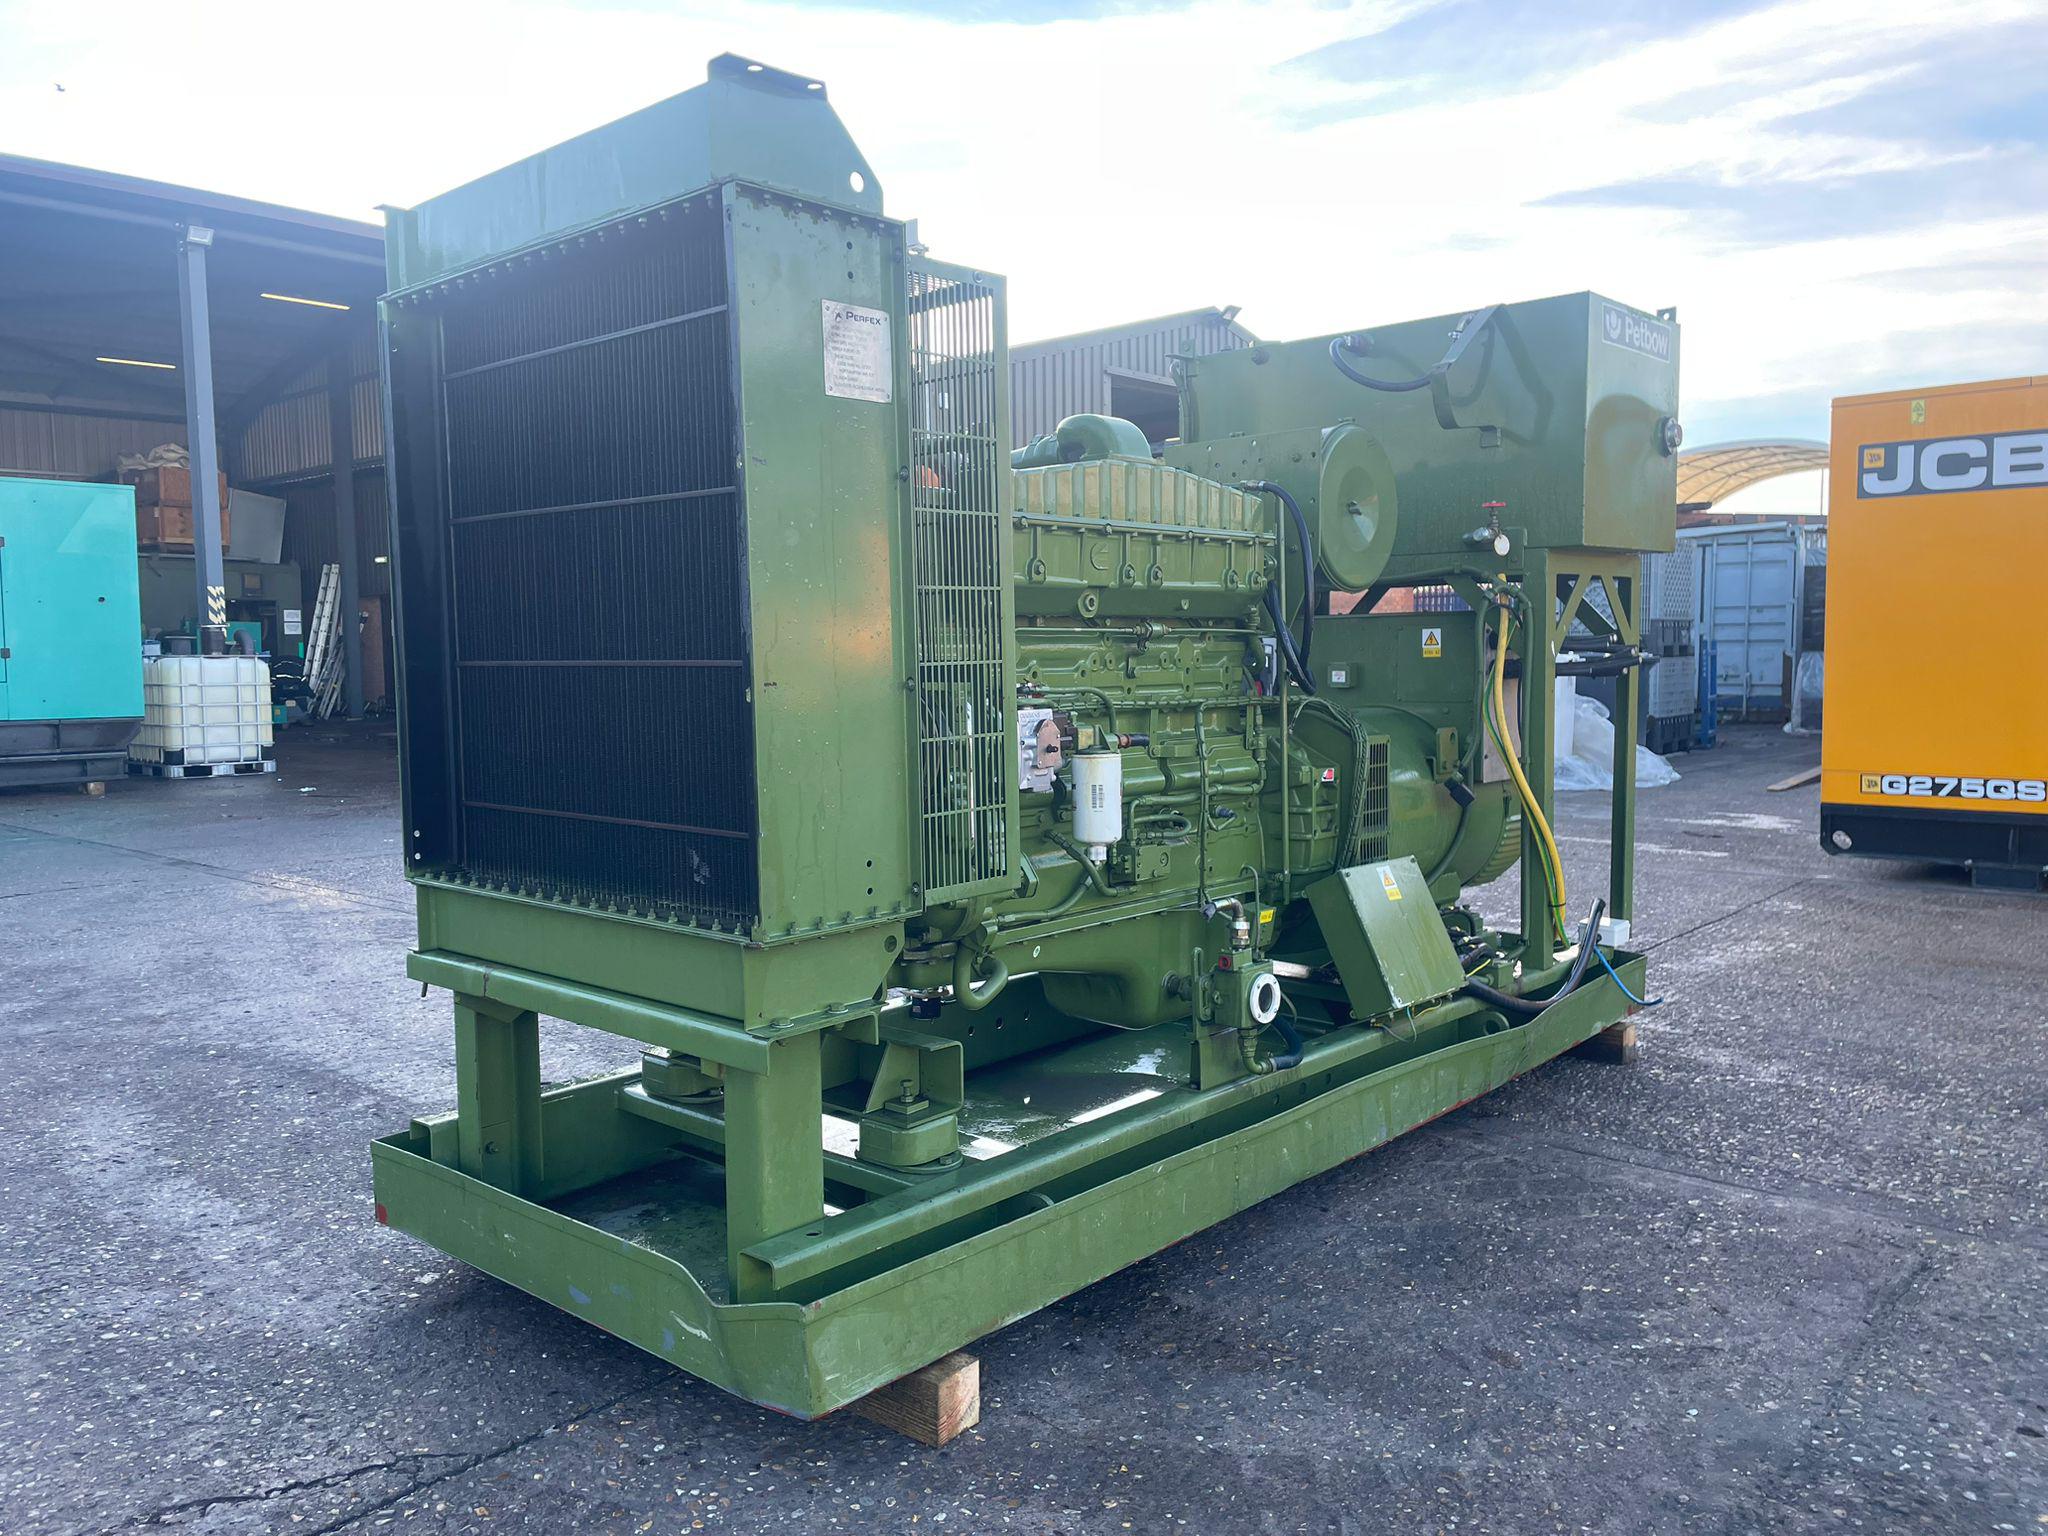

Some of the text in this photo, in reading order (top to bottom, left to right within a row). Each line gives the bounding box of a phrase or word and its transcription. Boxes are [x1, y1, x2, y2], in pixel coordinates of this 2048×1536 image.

[846, 311, 881, 325] PERFEX
[1625, 316, 1668, 355] Petbow
[1862, 433, 2048, 494] JCB
[1881, 775, 2046, 801] G275QS
